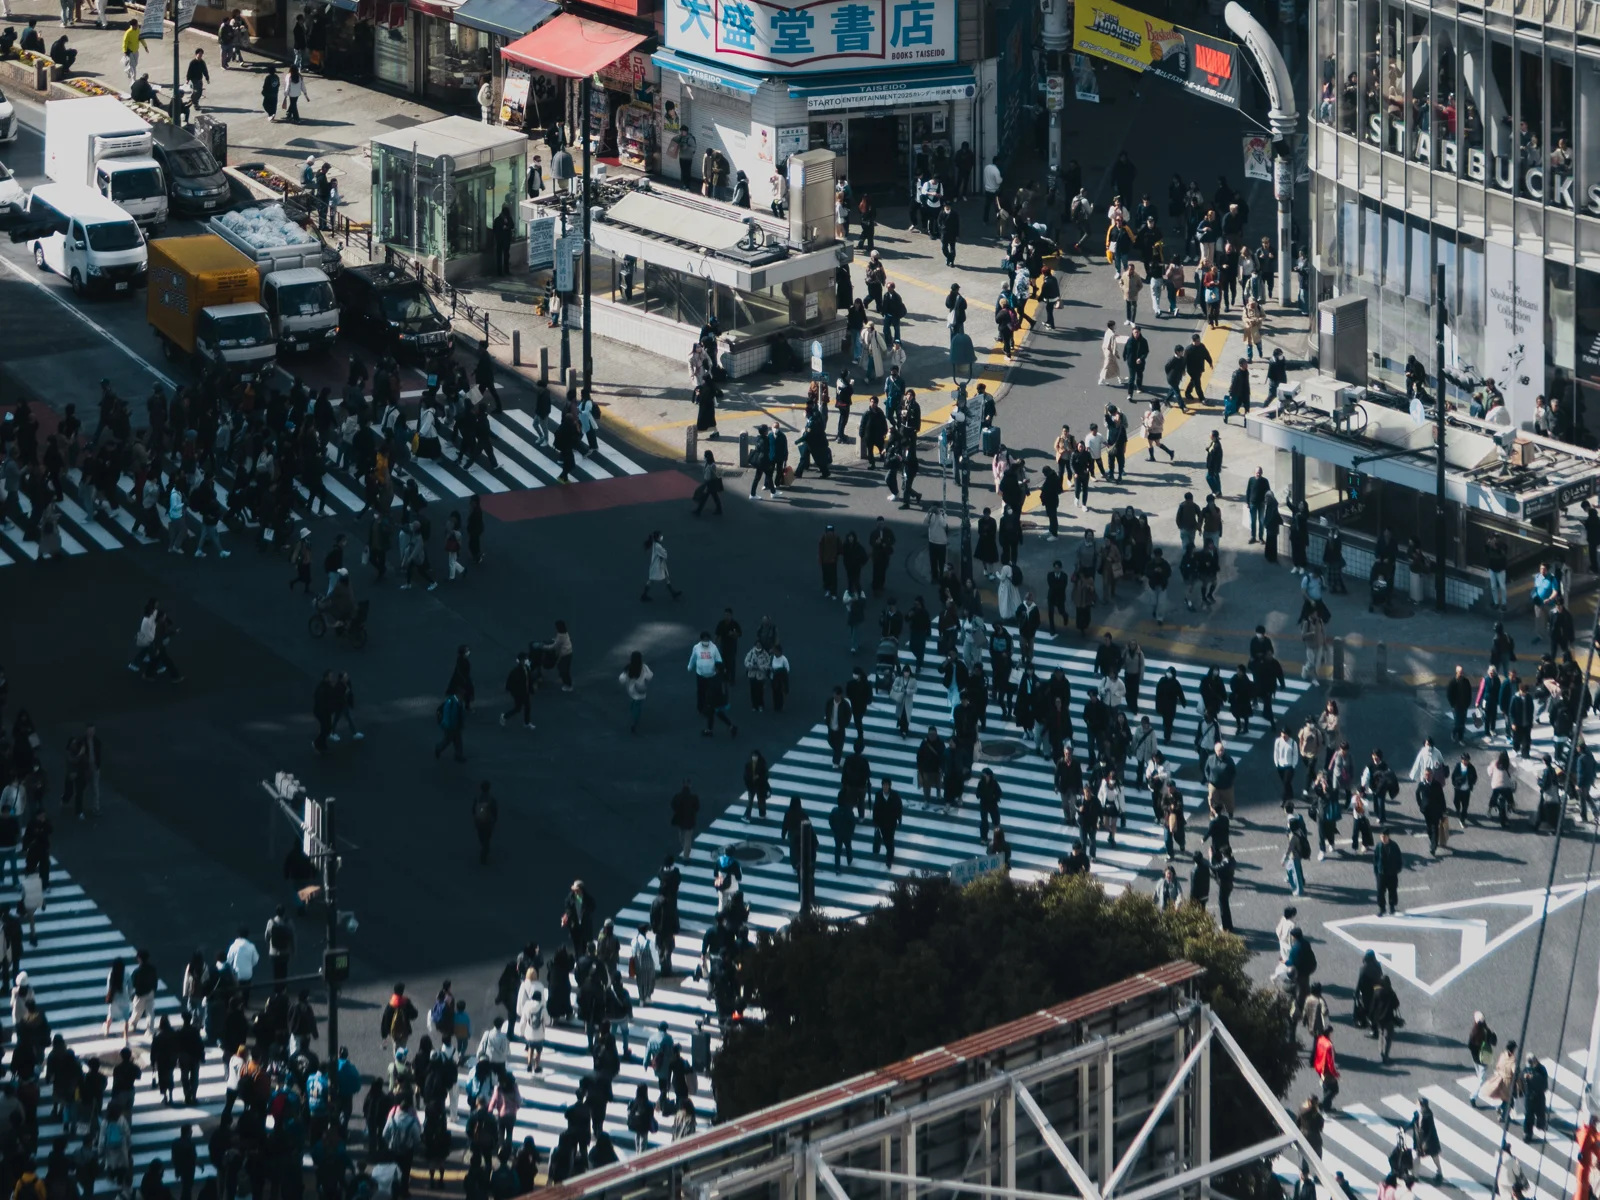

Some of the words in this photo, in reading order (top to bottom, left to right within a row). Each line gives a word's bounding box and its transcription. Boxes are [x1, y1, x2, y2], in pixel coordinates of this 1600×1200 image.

[891, 51, 913, 61] BOOKS
[915, 48, 945, 59] TAISEIDO
[688, 68, 722, 84] TAISEIDO
[860, 83, 907, 93] TAISEIDO
[808, 98, 841, 108] STARTO
[842, 93, 897, 104] ENTERTAINMENT
[1368, 112, 1600, 216] STARBUCKS
[1504, 317, 1525, 335] Toyo
